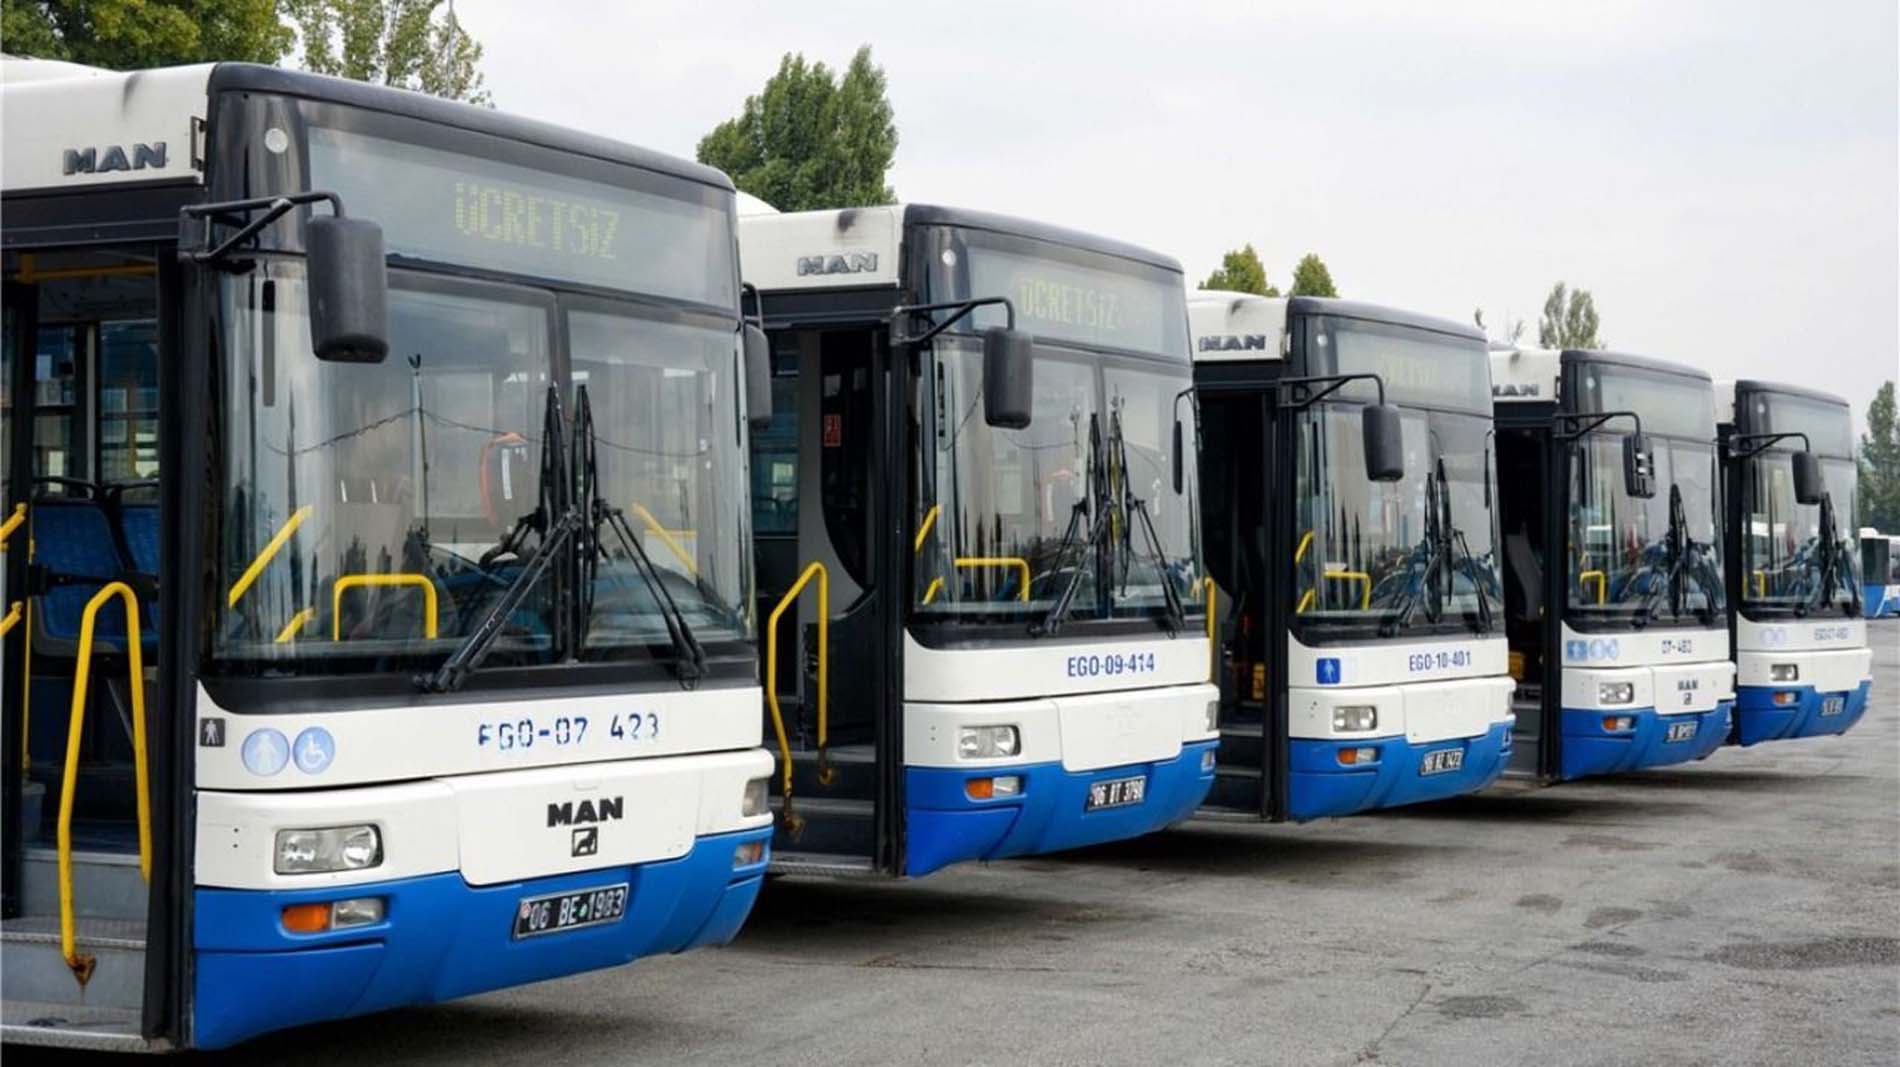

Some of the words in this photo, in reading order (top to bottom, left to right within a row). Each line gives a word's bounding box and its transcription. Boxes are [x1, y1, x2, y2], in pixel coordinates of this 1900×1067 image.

[63, 142, 167, 175] MAN
[797, 252, 878, 277] MAN
[1198, 334, 1266, 352] MAN
[1067, 652, 1155, 677] EGO-09-414
[1409, 650, 1471, 672] EGO-10-401
[546, 796, 624, 828] MAN
[529, 902, 551, 930] 06
[558, 896, 580, 926] BE
